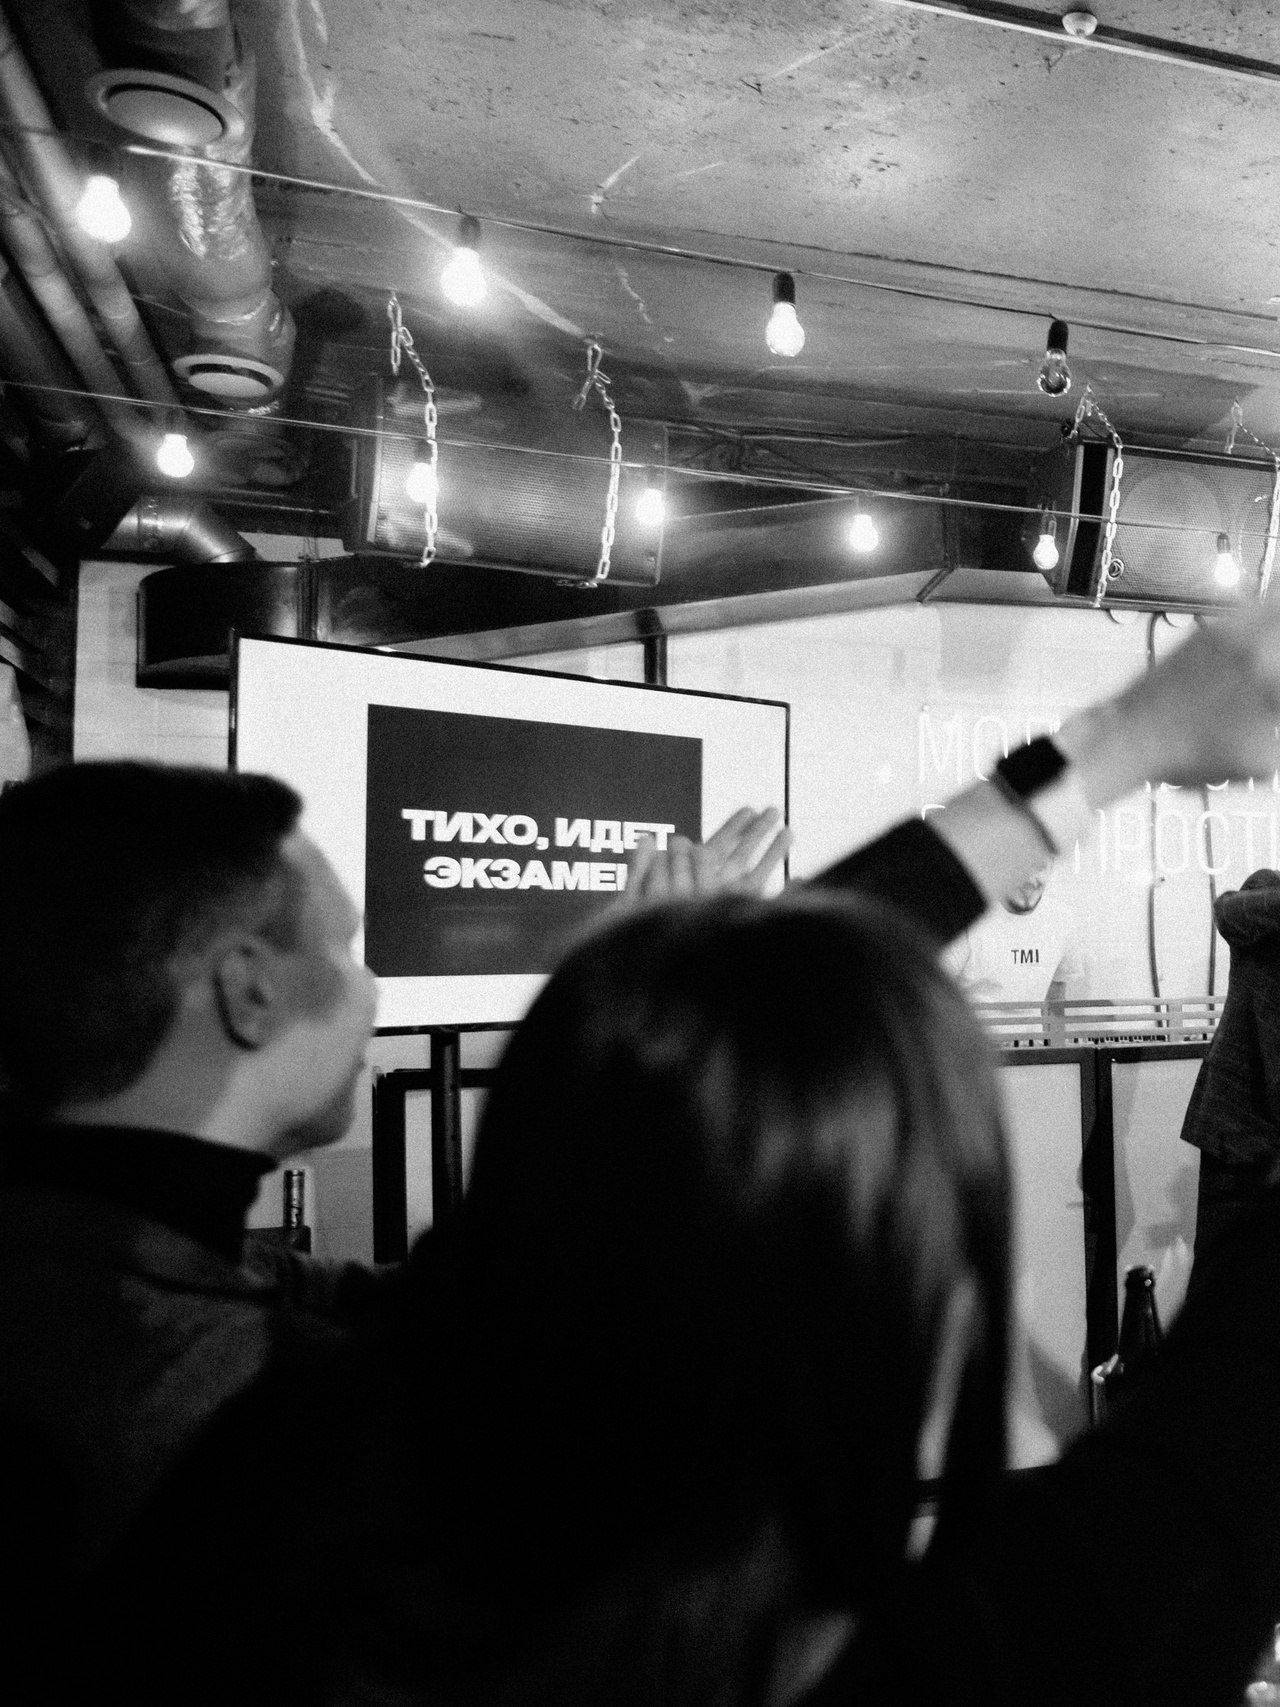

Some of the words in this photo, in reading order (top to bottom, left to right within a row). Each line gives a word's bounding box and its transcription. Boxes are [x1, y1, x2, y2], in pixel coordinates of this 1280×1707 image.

[401, 808, 550, 851] ТИХО,
[555, 816, 676, 853] ИДЕТ
[1010, 948, 1039, 965] TMI
